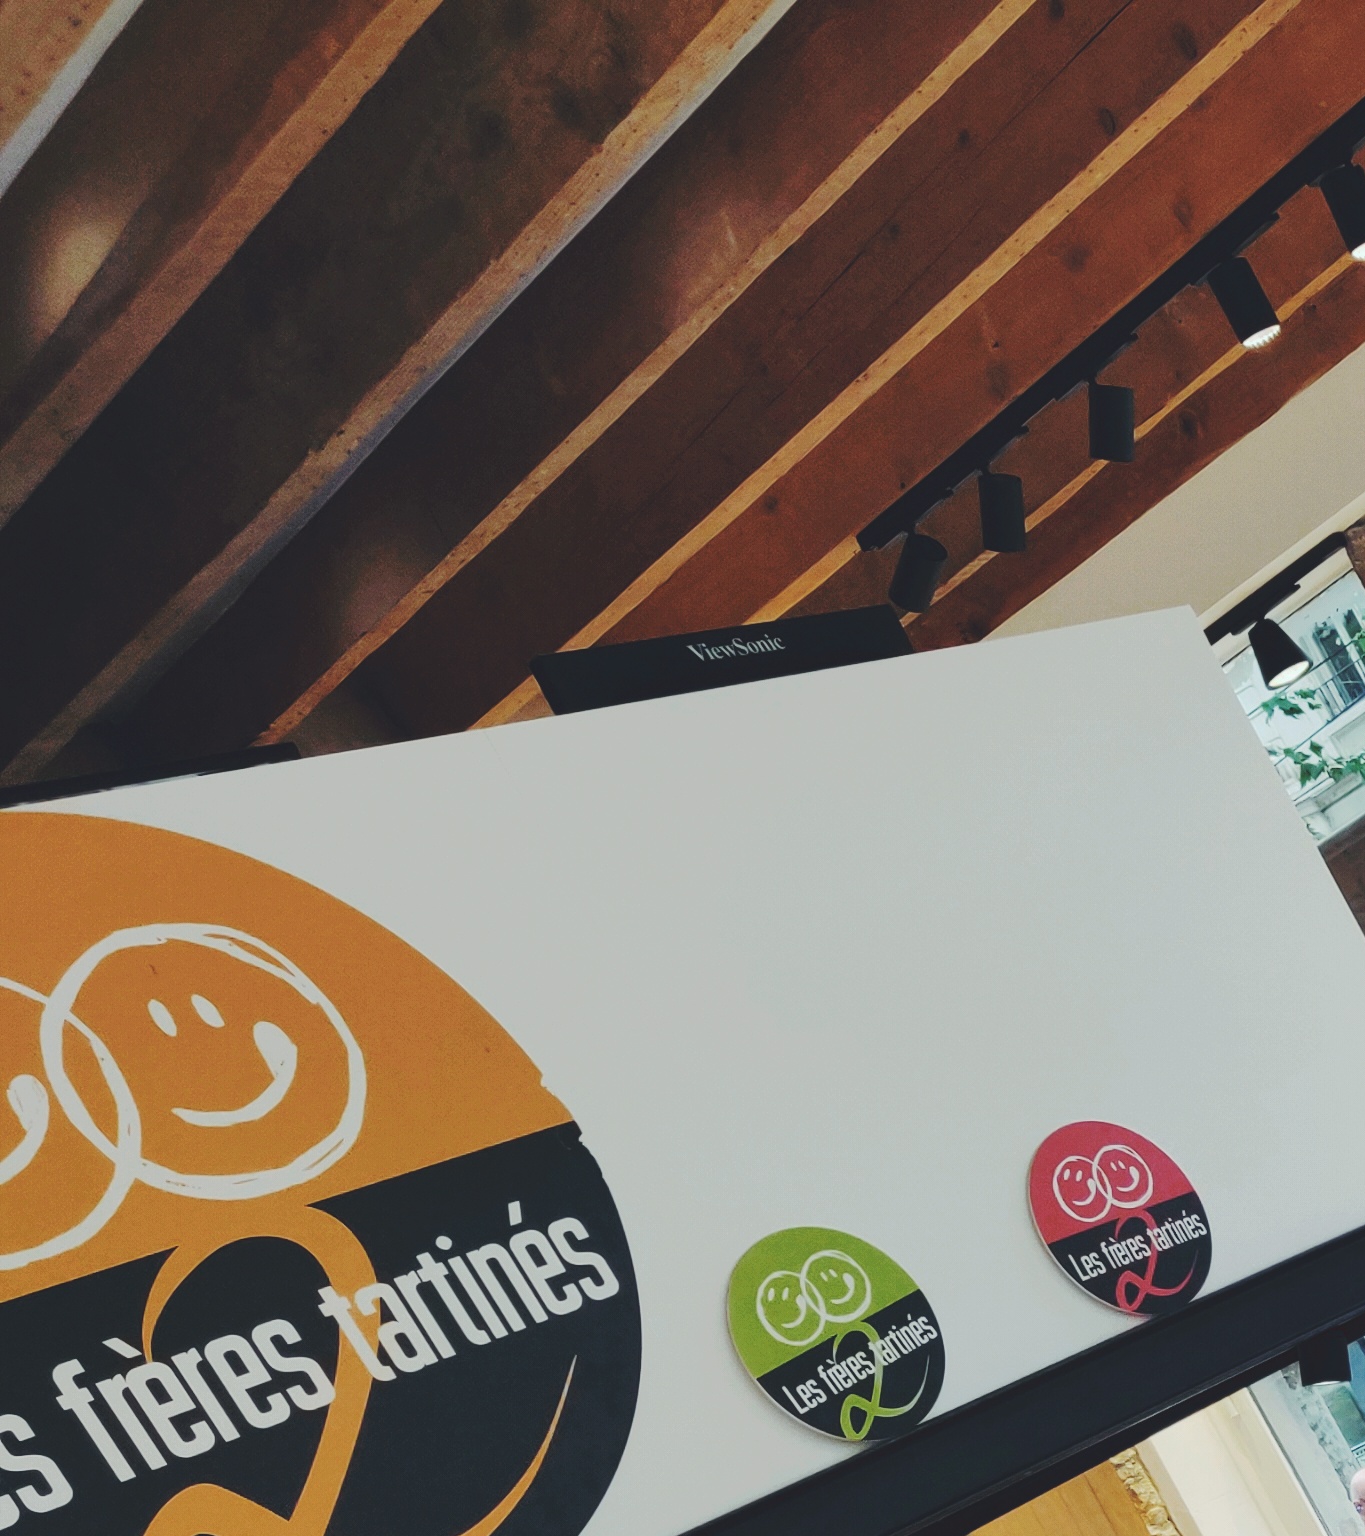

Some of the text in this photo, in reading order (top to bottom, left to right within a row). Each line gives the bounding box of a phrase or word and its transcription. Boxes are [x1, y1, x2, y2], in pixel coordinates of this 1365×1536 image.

[686, 633, 786, 663] ViewSonic
[1067, 1210, 1208, 1281] Les frères tartinés
[52, 1319, 336, 1482] frères
[319, 1201, 621, 1382] tartinés
[782, 1314, 938, 1416] Les frères tartinés
